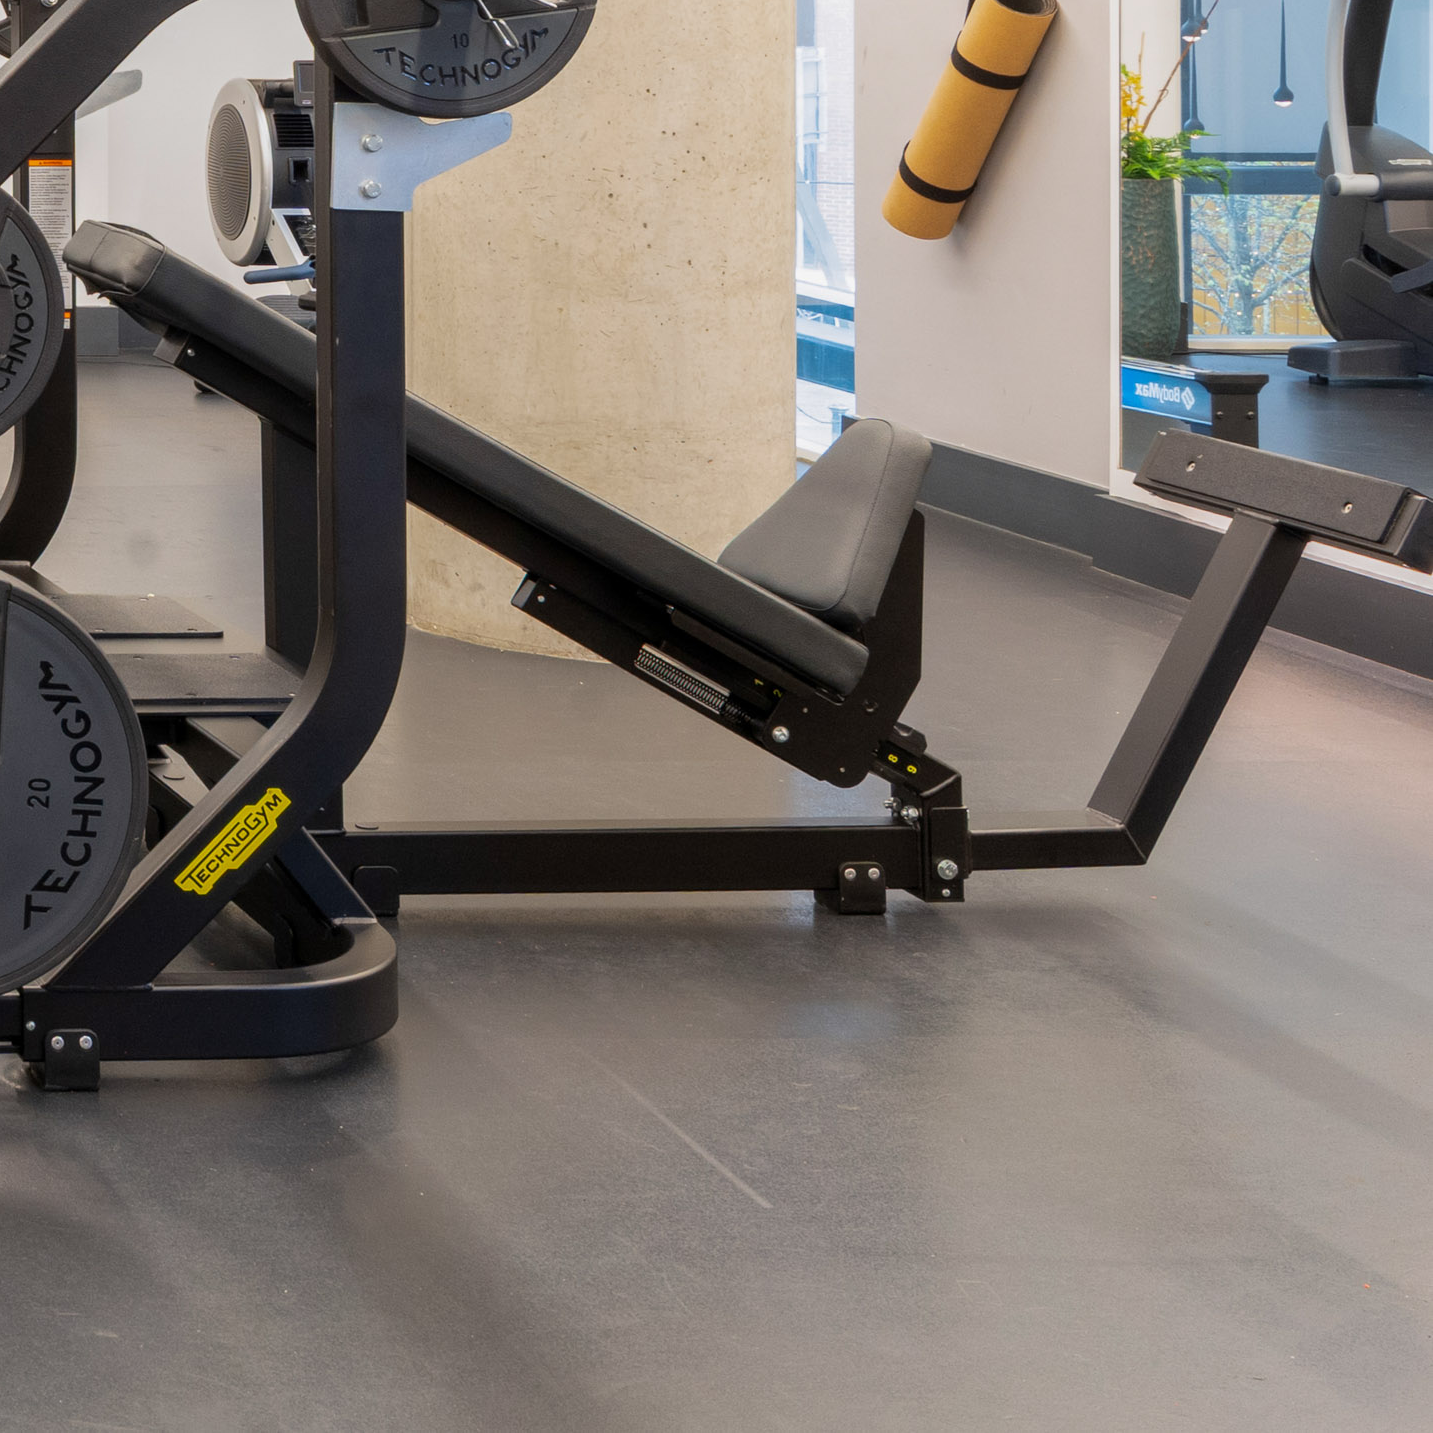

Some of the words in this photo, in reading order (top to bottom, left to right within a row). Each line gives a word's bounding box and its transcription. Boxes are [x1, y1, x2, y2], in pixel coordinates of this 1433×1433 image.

[373, 26, 550, 87] TECHNOGYM
[450, 32, 470, 49] 10
[888, 753, 898, 764] 8
[907, 765, 917, 775] 9
[23, 660, 106, 931] TECHNOGYM
[27, 777, 52, 810] 20
[180, 793, 283, 889] TECHNOGYM
